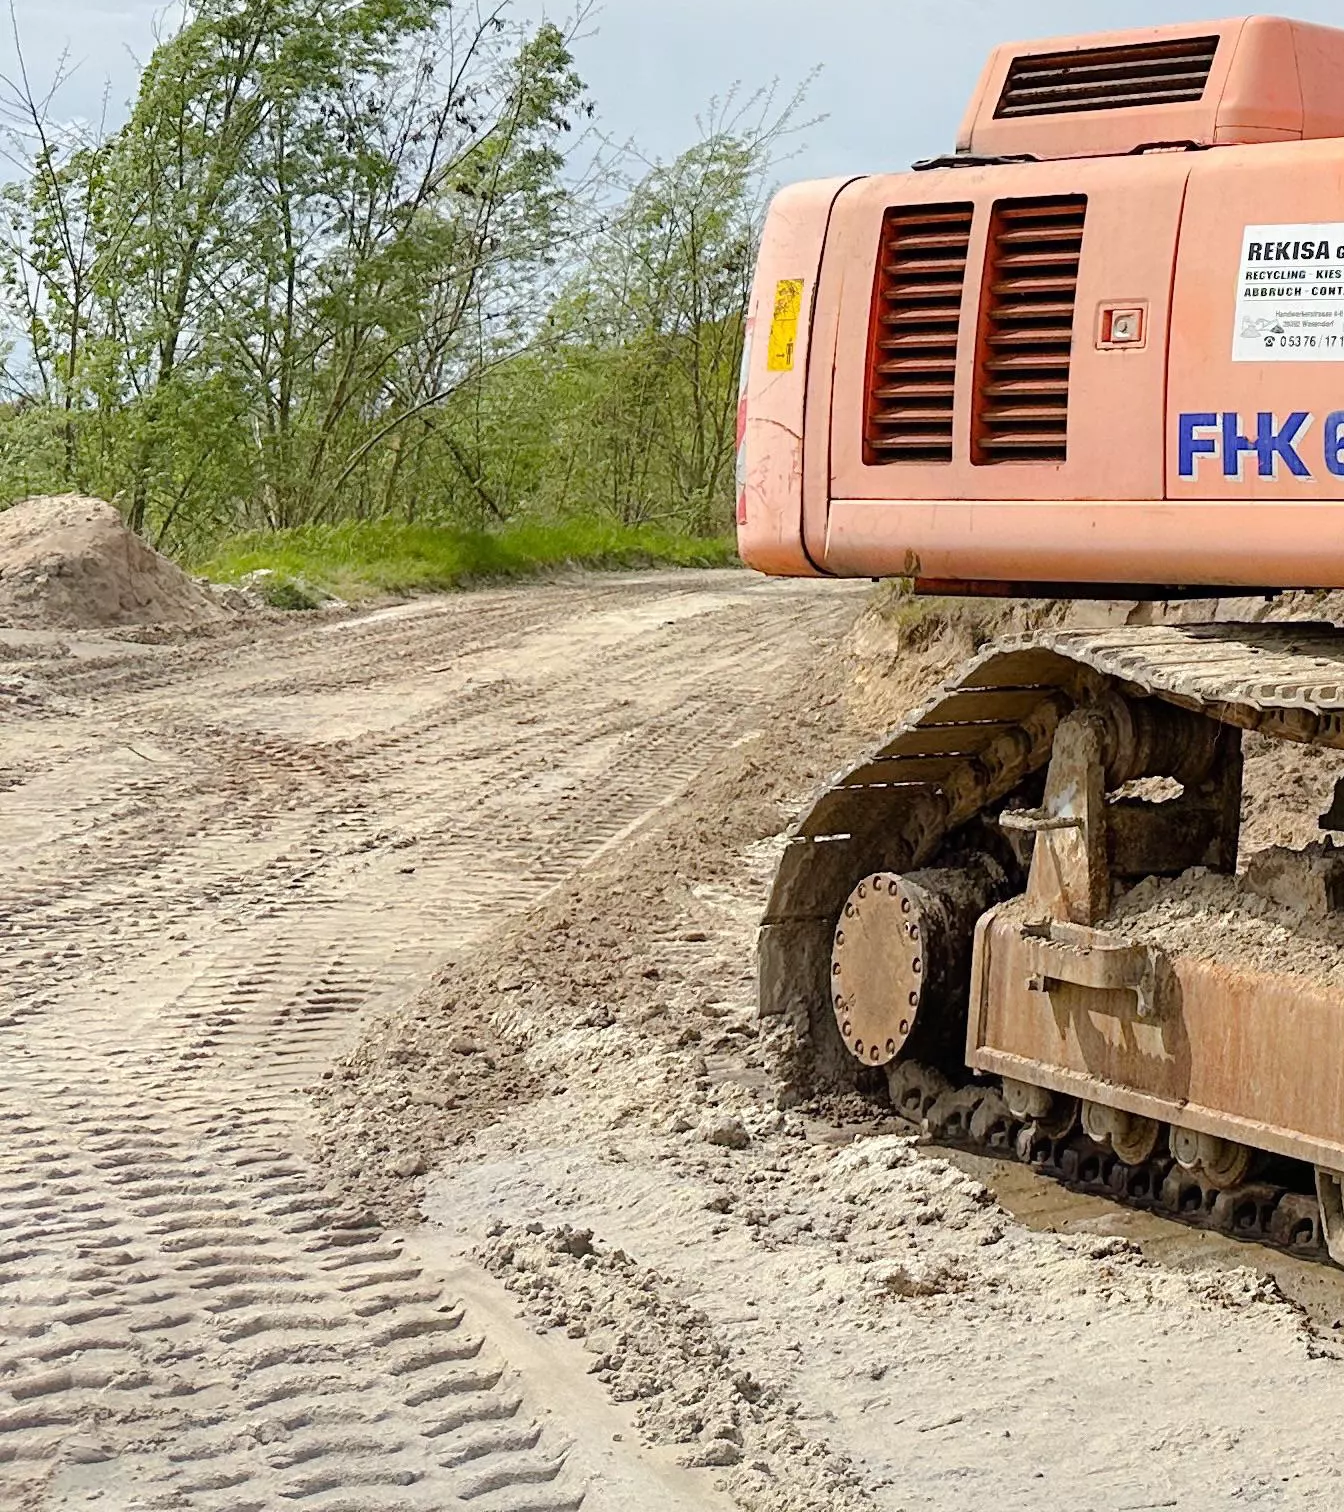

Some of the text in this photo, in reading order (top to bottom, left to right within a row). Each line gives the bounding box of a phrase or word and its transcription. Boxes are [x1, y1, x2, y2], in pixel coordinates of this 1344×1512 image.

[1247, 241, 1330, 261] REKISA
[1245, 270, 1306, 280] RECYCLING
[1316, 269, 1342, 279] KIES
[1244, 287, 1302, 297] ABBRUCH
[1178, 411, 1316, 481] FHK
